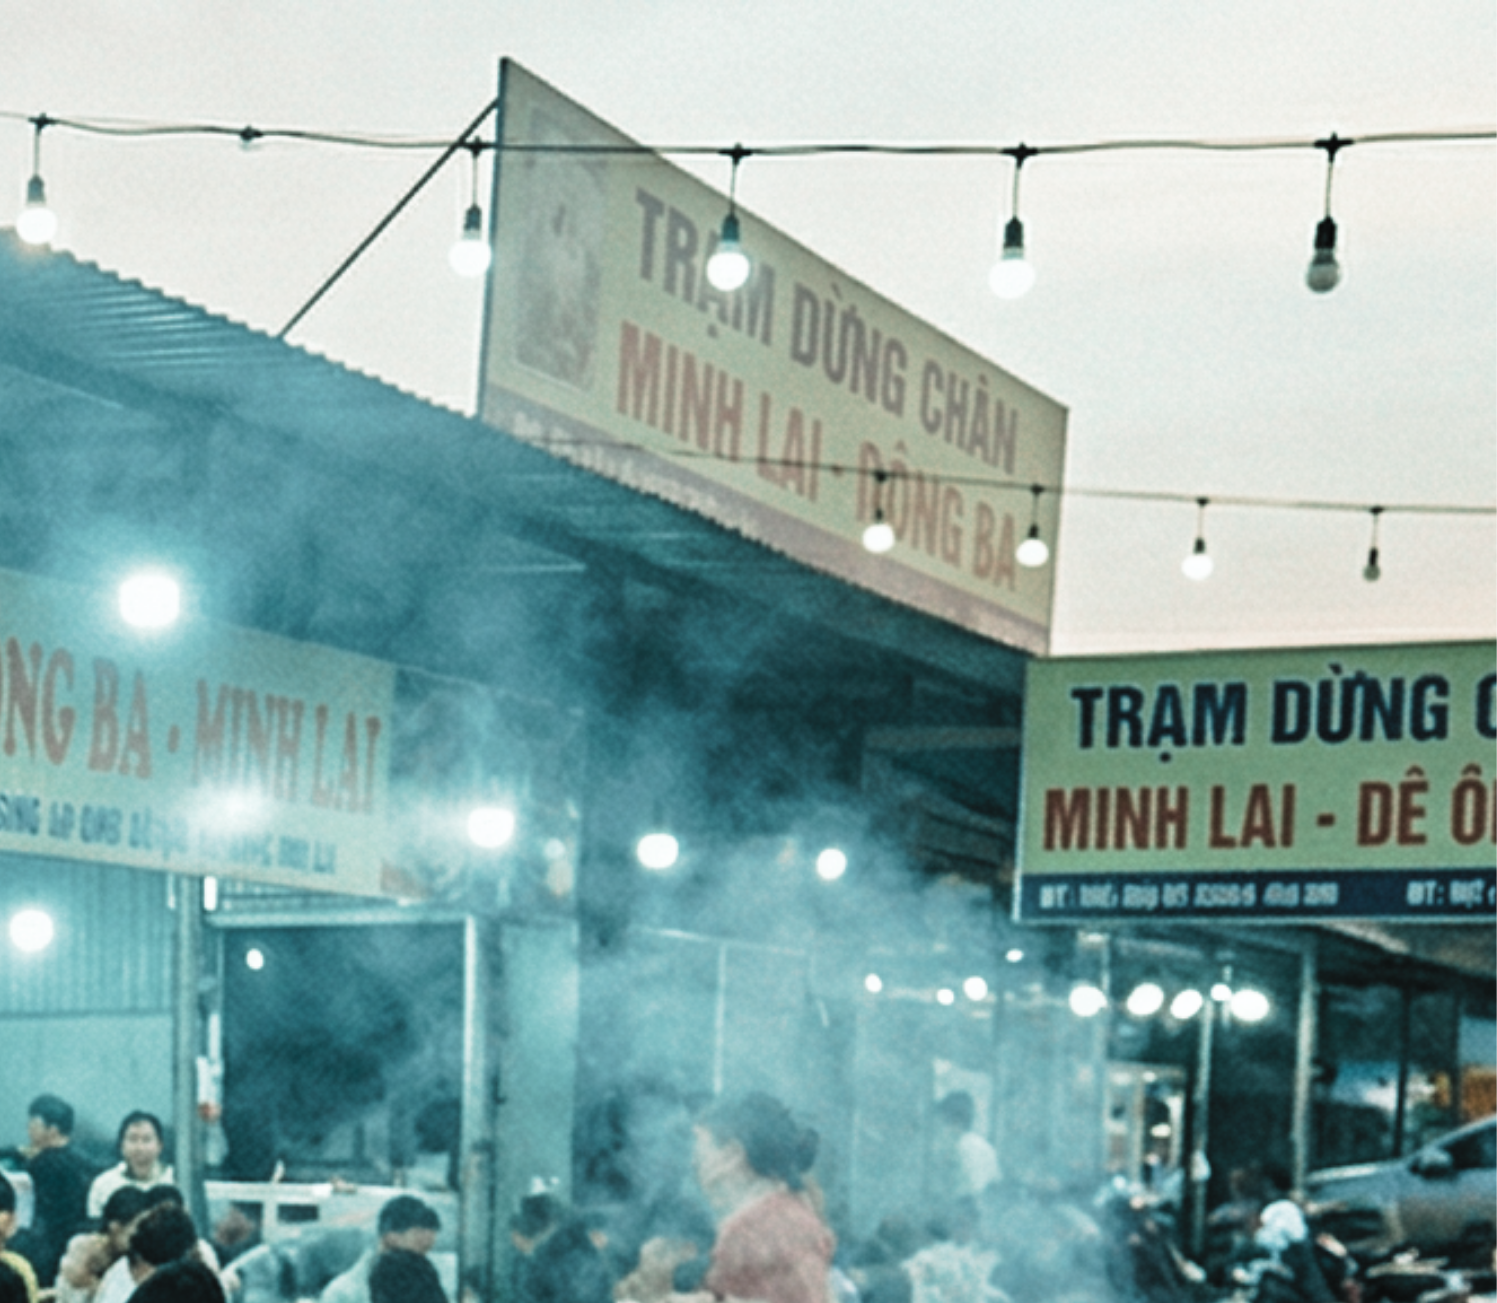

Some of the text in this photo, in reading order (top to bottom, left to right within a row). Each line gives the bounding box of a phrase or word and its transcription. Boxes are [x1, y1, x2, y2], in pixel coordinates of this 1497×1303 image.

[791, 282, 908, 418] DỪNG
[617, 319, 744, 463] MINH
[757, 391, 821, 504] LAI
[973, 501, 1016, 592] BA
[88, 657, 152, 779] BA
[312, 704, 381, 815] LAI
[1070, 681, 1247, 763] TRẠM
[1271, 663, 1450, 745] DỪNG
[1043, 785, 1189, 852] MINH
[1209, 784, 1295, 849] LAI
[1357, 764, 1430, 848] DÊ
[1452, 762, 1497, 847] Ô
